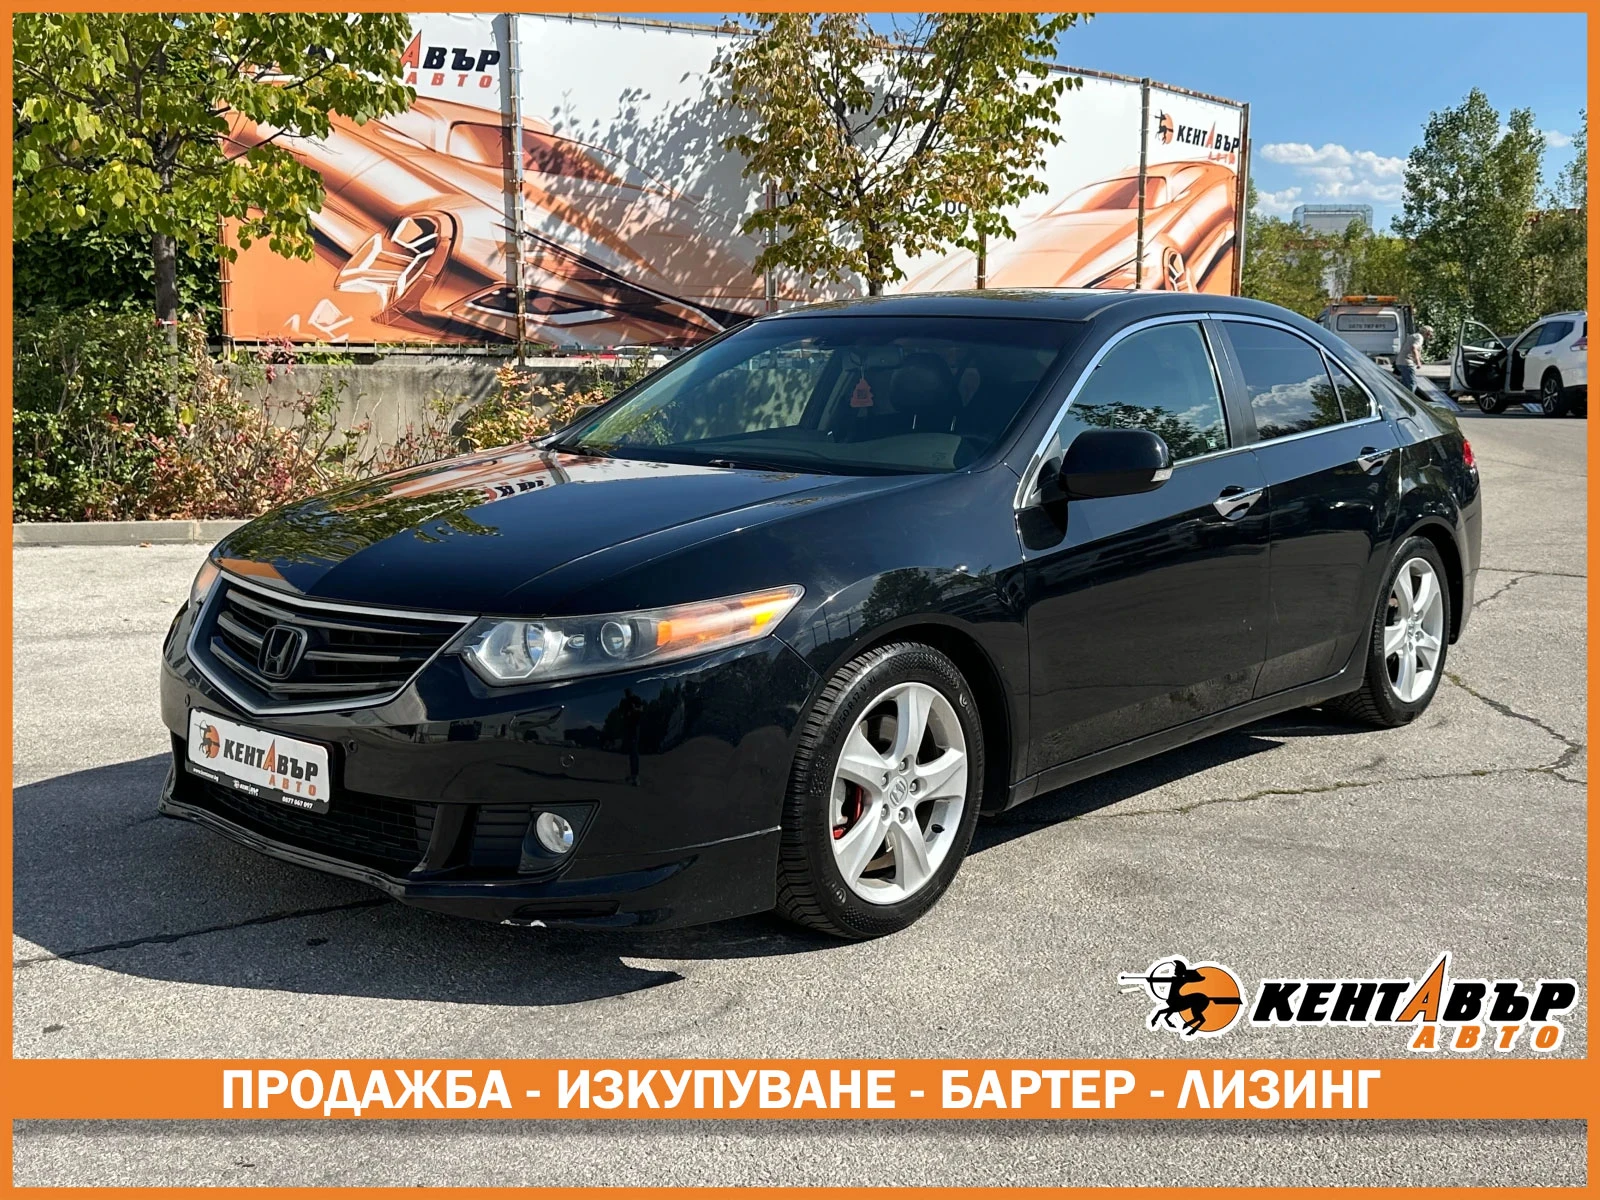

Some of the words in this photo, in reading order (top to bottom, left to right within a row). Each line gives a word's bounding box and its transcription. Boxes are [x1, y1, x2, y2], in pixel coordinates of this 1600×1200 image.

[405, 71, 493, 88] АВТО
[1176, 121, 1240, 153] КЕНТАВЪР
[223, 738, 319, 782] КЕНТАВЪР
[268, 774, 317, 797] АВТО
